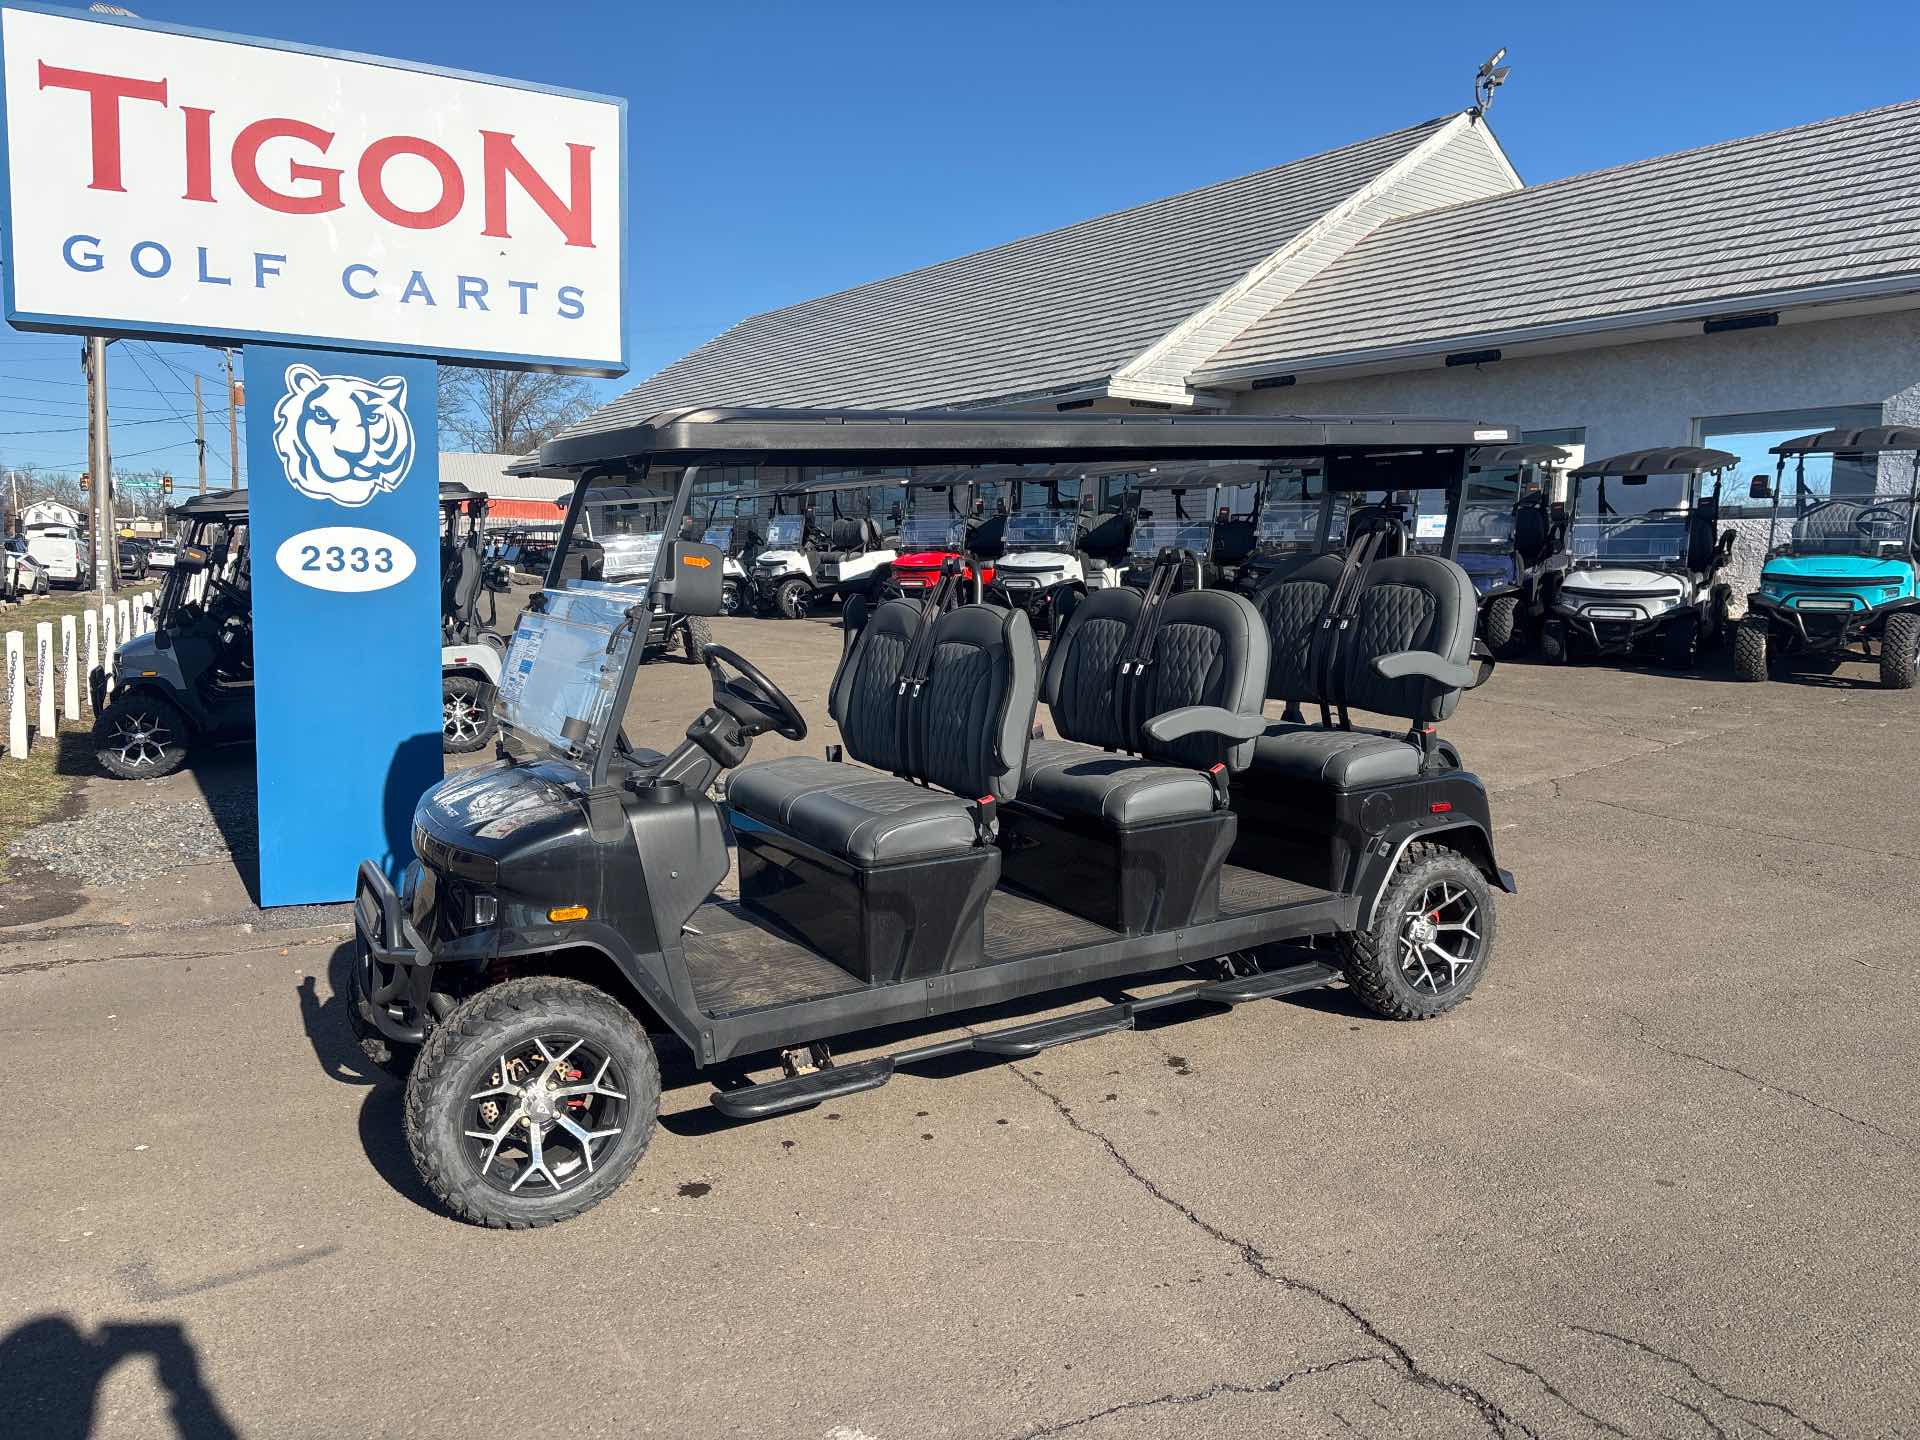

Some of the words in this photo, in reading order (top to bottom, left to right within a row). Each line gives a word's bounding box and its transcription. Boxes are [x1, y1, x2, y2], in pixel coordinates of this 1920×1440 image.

[38, 59, 596, 248] TIGON
[62, 234, 287, 289] GOLF
[341, 263, 585, 320] CARTS
[301, 545, 394, 573] 2333
